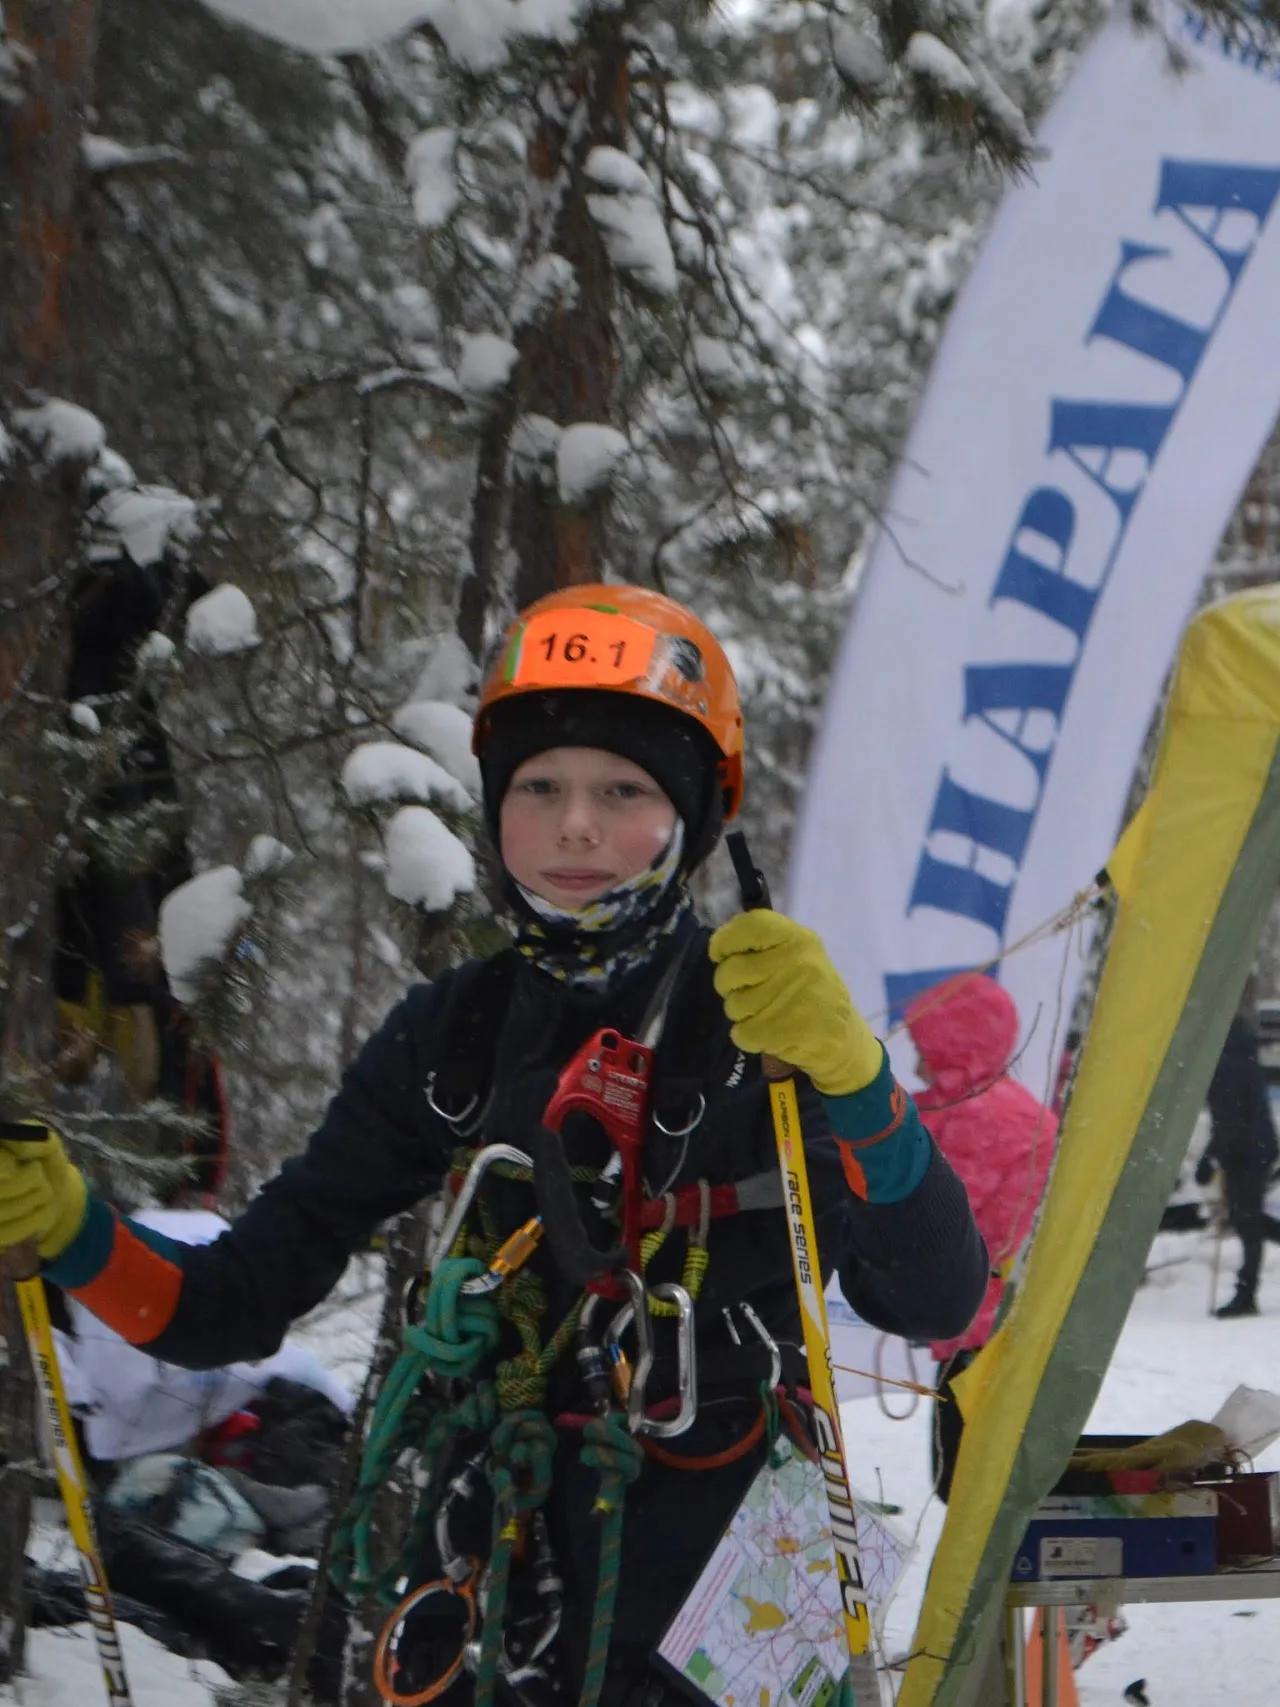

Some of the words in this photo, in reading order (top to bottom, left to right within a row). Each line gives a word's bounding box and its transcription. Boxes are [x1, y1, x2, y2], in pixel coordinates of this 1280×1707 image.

[540, 632, 627, 669] 16.1
[786, 1170, 803, 1216] race
[793, 1222, 812, 1284] series
